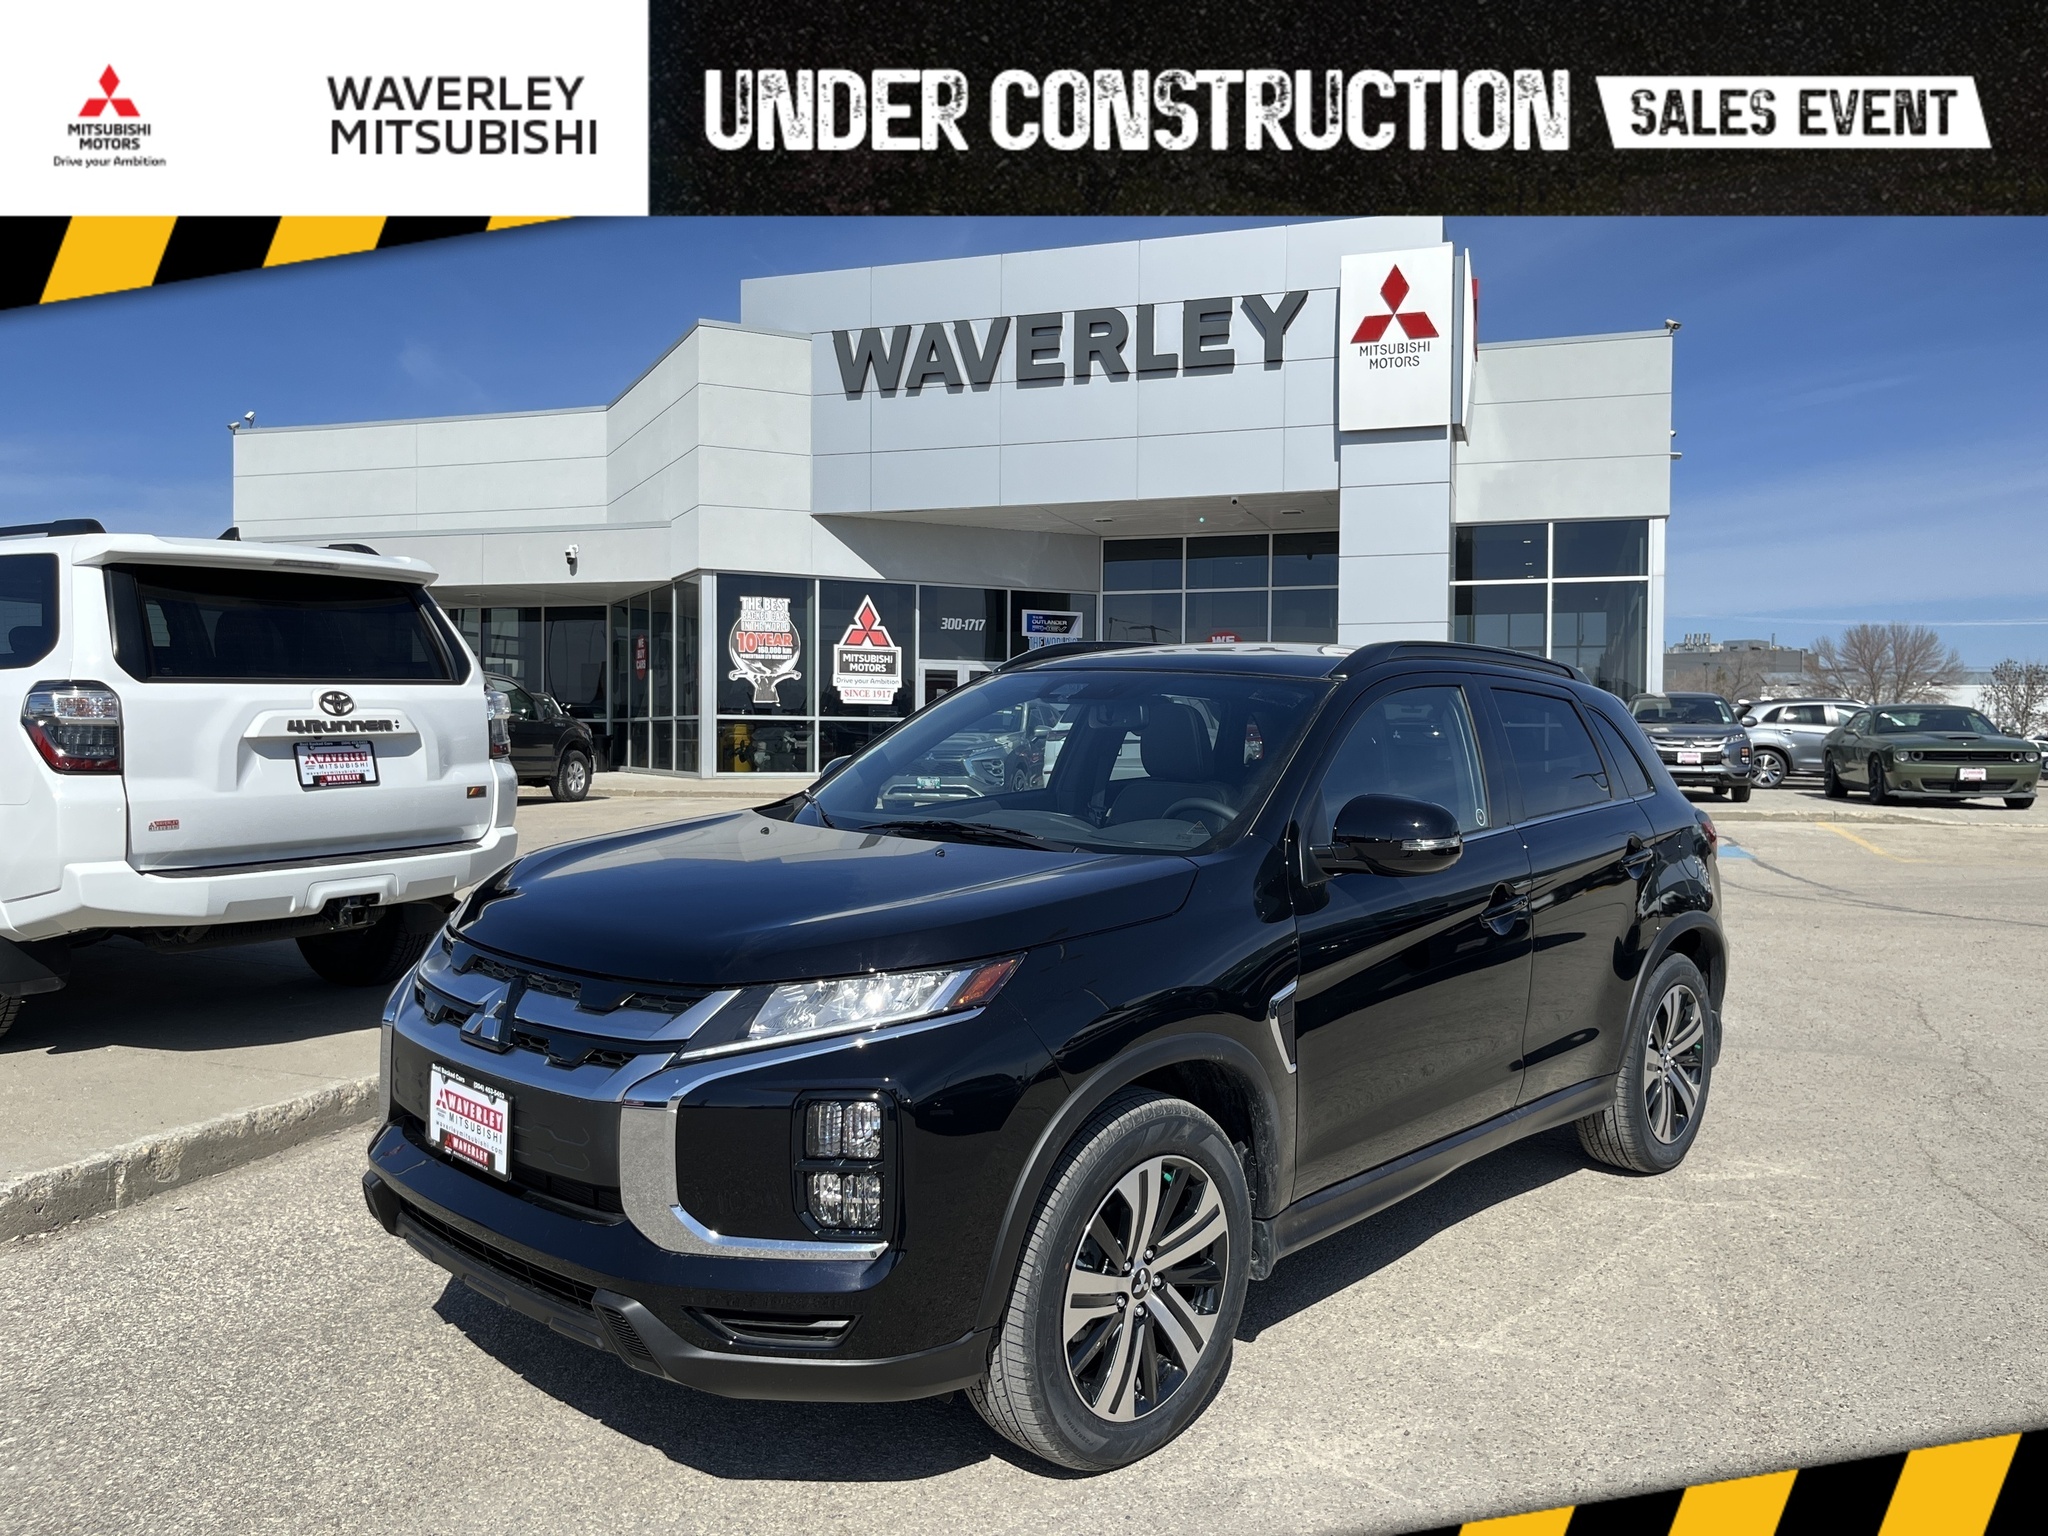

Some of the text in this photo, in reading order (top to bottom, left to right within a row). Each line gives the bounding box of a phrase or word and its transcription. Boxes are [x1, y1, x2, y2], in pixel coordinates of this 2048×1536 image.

[832, 289, 1309, 398] WAVERLEY
[1359, 341, 1430, 357] MITSUBISHI
[1369, 355, 1420, 370] MOTORS
[740, 597, 791, 611] THE BEST
[750, 621, 763, 631] THE
[764, 622, 790, 632] WORLD
[940, 617, 986, 631] 300-1717
[737, 632, 793, 653] 10 YEAR
[842, 653, 893, 664] MITSUBISHI
[849, 663, 887, 673] MOTORS
[844, 689, 892, 698] SINCE 1917
[316, 753, 367, 763] WAVERLEY
[326, 774, 360, 782] WAVERLEY
[448, 1093, 503, 1131] WAVERLEY
[449, 1112, 503, 1145] MITSUBISHI
[452, 1136, 489, 1163] WAVERLEY
